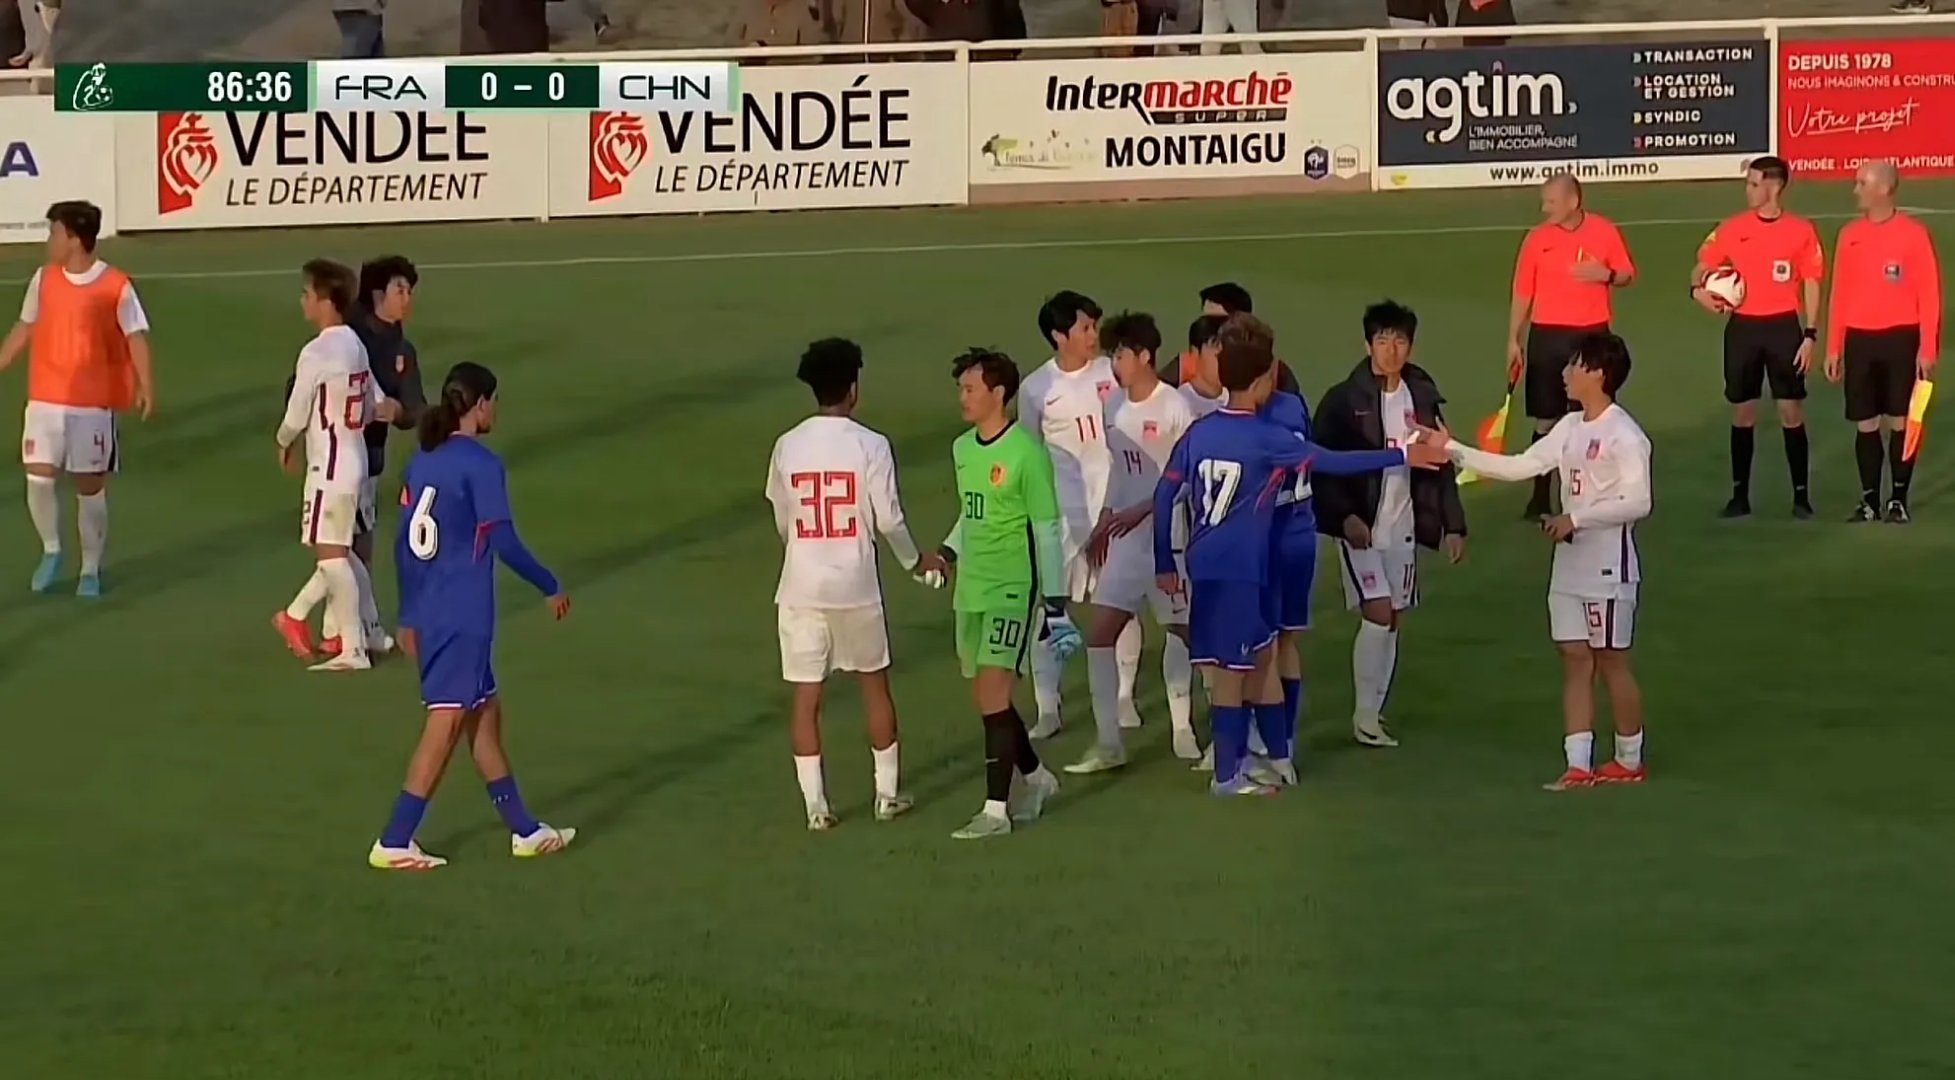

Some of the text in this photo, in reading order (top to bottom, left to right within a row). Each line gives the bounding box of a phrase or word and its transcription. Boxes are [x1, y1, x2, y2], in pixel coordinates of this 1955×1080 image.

[1644, 48, 1753, 64] TRANSACTION
[1788, 53, 1892, 71] DEPUIS 1978
[1644, 72, 1721, 87] LOCATION
[1645, 84, 1735, 99] ET GESTION
[1788, 76, 1822, 90] NOUS
[1824, 74, 1891, 88] IMAGINONS
[658, 74, 911, 154] VENDÉE
[1644, 110, 1701, 124] SYNDIC
[1787, 97, 1920, 138] Votre projet
[1106, 133, 1287, 168] MONTAIGU
[1645, 132, 1735, 148] PROMOTION
[655, 158, 910, 194] LE DÉPARTEMENT
[1788, 157, 1836, 172] VENDÉE
[226, 171, 489, 207] LE DÉPARTEMENT
[93, 430, 105, 455] 4
[1075, 414, 1097, 443] 11
[1123, 449, 1142, 476] 14
[791, 471, 857, 539] 32
[965, 491, 984, 520] 30
[1198, 458, 1242, 527] 17
[409, 486, 439, 561] 6
[1582, 602, 1602, 628] 15
[989, 617, 1021, 648] 30
